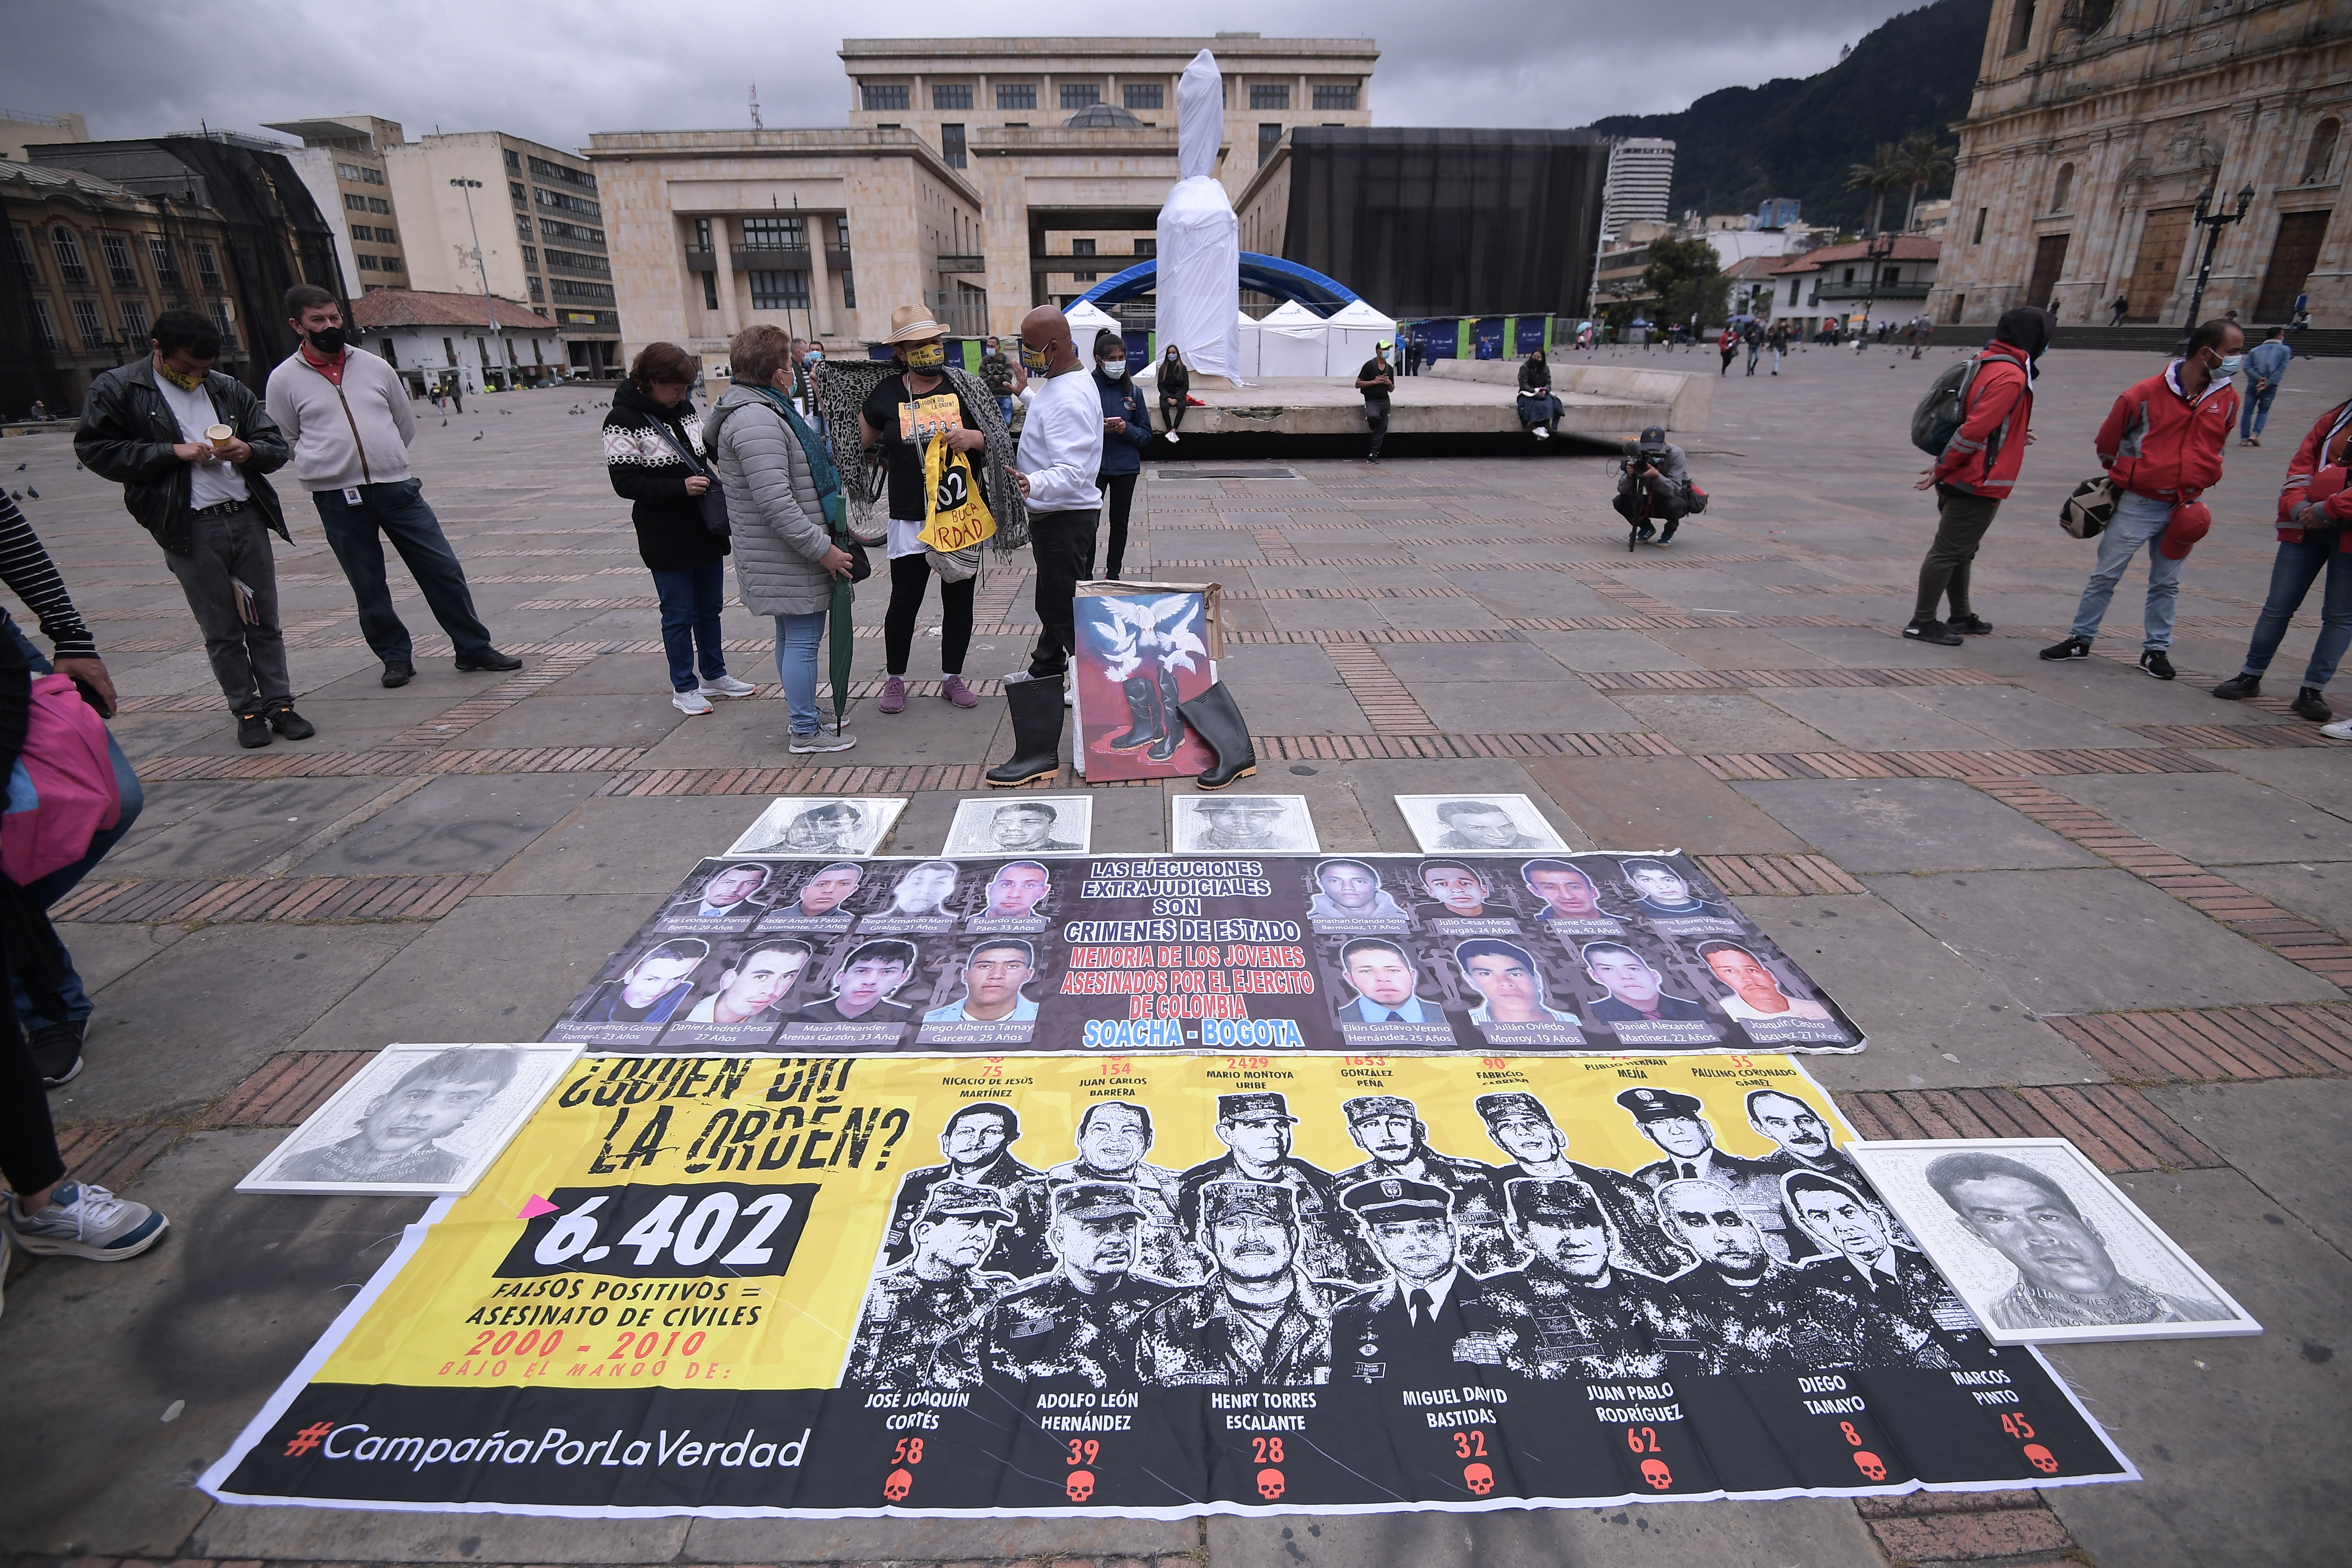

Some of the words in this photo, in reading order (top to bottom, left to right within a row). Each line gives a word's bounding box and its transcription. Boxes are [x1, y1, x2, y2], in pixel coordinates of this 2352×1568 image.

[1090, 862, 1130, 878] LAS
[1132, 861, 1263, 877] EJECUCIONES
[1081, 879, 1271, 899] EXTRAJUDICIALES
[1152, 899, 1202, 916] SON
[1063, 919, 1177, 942] CRIMENES
[1180, 920, 1211, 942] DE
[1216, 919, 1301, 942] ESTADO
[1069, 945, 1153, 968] MEMORIA
[1158, 946, 1181, 967] DE
[1187, 945, 1220, 967] LOS
[1224, 945, 1306, 968] JOVENES
[1060, 971, 1167, 995] ASESINADOS
[1171, 971, 1205, 993] POR
[1209, 971, 1231, 993] EL
[1234, 970, 1315, 994] EJERCITO
[1130, 995, 1152, 1020] DE
[1157, 995, 1248, 1020] COLOMBIA
[670, 1024, 705, 1032] Daniel
[707, 1024, 741, 1032] Andrés
[743, 1024, 774, 1032] Pesca,
[1082, 1019, 1183, 1048] SOACHA
[1201, 1018, 1305, 1048] BOGOTA
[1343, 1024, 1368, 1033] Elkin
[1494, 1022, 1525, 1031] Julián
[1527, 1022, 1565, 1031] Oviedo
[1614, 1023, 1651, 1031] Daniel
[1652, 1022, 1704, 1030] Alexander
[710, 1034, 738, 1043] Años
[824, 1033, 856, 1041] Garzón,
[1349, 1033, 1408, 1042] Hernández,
[1425, 1034, 1452, 1043] Años
[1490, 1034, 1536, 1045] Monroy,
[1537, 1034, 1550, 1042] 19
[1552, 1034, 1580, 1043] Años
[1621, 1034, 1672, 1042] Martínez,
[1689, 1034, 1716, 1042] Años
[1102, 1063, 1131, 1075] 154
[1227, 1057, 1269, 1069] 2429
[1344, 1056, 1385, 1066] 1653
[1483, 1058, 1505, 1070] 90
[1584, 1063, 1623, 1071] PUBLIO
[1731, 1055, 1754, 1068] 55
[982, 1065, 1002, 1077] 75
[1207, 1070, 1241, 1078] MARIO
[1244, 1070, 1294, 1079] MONTOYA
[1341, 1067, 1393, 1077] GONZÁLEZ
[1476, 1071, 1524, 1079] FABRICIO
[1618, 1069, 1649, 1079] MEJÍA
[1692, 1068, 1735, 1078] PAULINO
[1737, 1068, 1797, 1077] CORONADO
[765, 1059, 856, 1103] DIO
[942, 1077, 986, 1085] NICACIO
[1005, 1076, 1033, 1085] JESÚS
[1357, 1079, 1384, 1088] PEÑA
[1735, 1078, 1773, 1088] GÁMEZ
[959, 1088, 1013, 1097] MARTÍNEZ
[1090, 1088, 1135, 1096] BARRERA
[588, 1105, 675, 1174] LA
[684, 1105, 910, 1173] ORDEN?
[534, 1192, 793, 1266] 6.402
[490, 1277, 585, 1300] FALSOS
[591, 1282, 730, 1302] POSITIVOS
[466, 1305, 610, 1327] ASESINATO
[616, 1308, 651, 1327] DE
[663, 1305, 762, 1327] CIVILES
[465, 1329, 564, 1358] 2000
[607, 1331, 707, 1360] 2010
[438, 1360, 509, 1377] BAJO
[523, 1361, 547, 1377] EL
[566, 1360, 667, 1377] MANDO
[685, 1362, 731, 1379] DE:
[1950, 1369, 2011, 1386] MARCOS
[1586, 1385, 1625, 1402] JUAN
[1626, 1382, 1674, 1402] PABLO
[1797, 1375, 1847, 1394] DIEGO
[864, 1390, 901, 1409] JOSÉ
[902, 1390, 969, 1409] JOAQUÍN
[1037, 1393, 1096, 1409] ADOLFO
[1101, 1390, 1139, 1409] LEÓN
[1211, 1392, 1259, 1409] HENRY
[1263, 1392, 1317, 1409] TORRES
[1402, 1390, 1462, 1406] MIGUEL
[1465, 1387, 1508, 1404] DAVID
[1971, 1389, 2020, 1406] PINTO
[1595, 1403, 1684, 1423] RODRÍGUEZ
[1803, 1396, 1865, 1415] TAMAYO
[886, 1410, 939, 1430] CORTÉS
[1041, 1411, 1132, 1432] HERNÁNDEZ
[1226, 1415, 1306, 1431] ESCALANTE
[1426, 1408, 1497, 1428] BASTIDAS
[2001, 1412, 2035, 1439] 45
[1628, 1426, 1661, 1453] 62
[1840, 1421, 1862, 1446] 8
[284, 1421, 811, 1472] #CampañaPorLaVerdad
[891, 1437, 924, 1465] 58
[1067, 1438, 1099, 1465] 39
[1252, 1437, 1284, 1463] 28
[1454, 1430, 1488, 1458] 32
